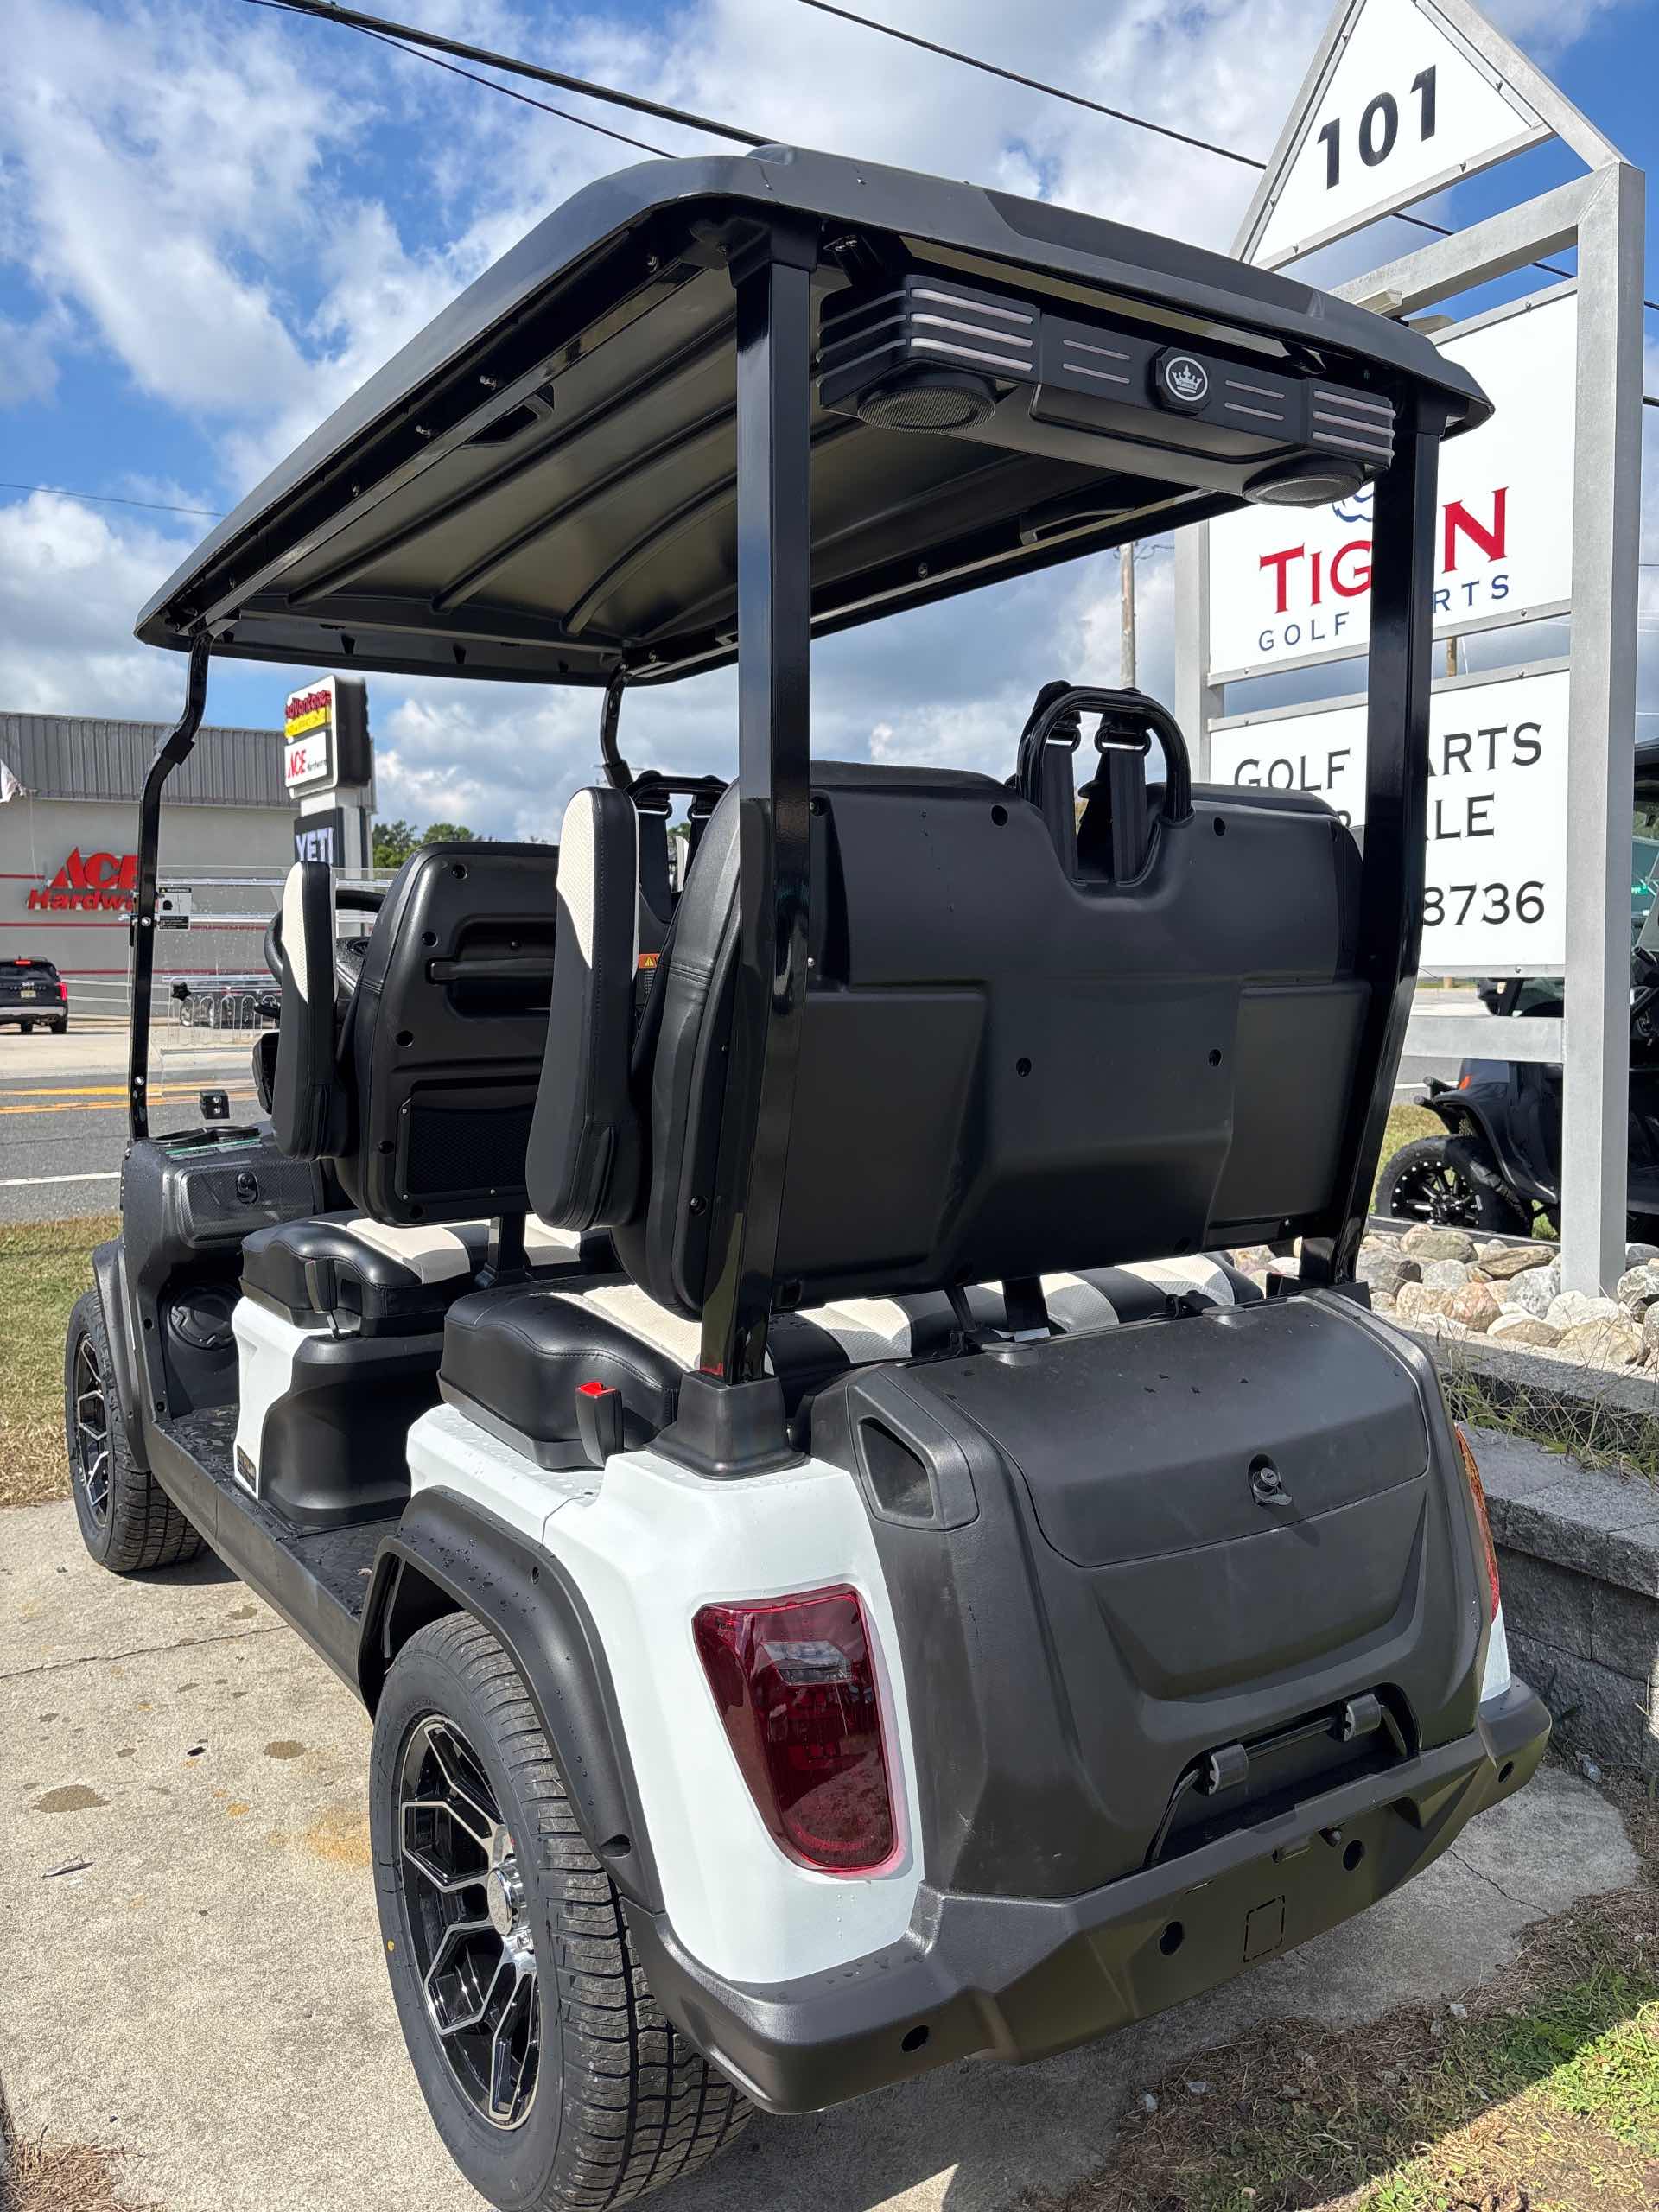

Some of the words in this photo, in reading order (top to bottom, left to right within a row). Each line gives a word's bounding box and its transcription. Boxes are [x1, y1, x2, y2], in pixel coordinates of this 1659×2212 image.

[1316, 64, 1437, 191] 101
[1259, 486, 1510, 614] TIGN
[1258, 611, 1350, 652] GOLF
[1433, 574, 1510, 614] RTS
[288, 748, 306, 779] ACE
[1234, 747, 1351, 792] GOLF
[1428, 721, 1542, 778] RTS
[296, 827, 334, 865] YETI
[27, 887, 134, 912] Hardw
